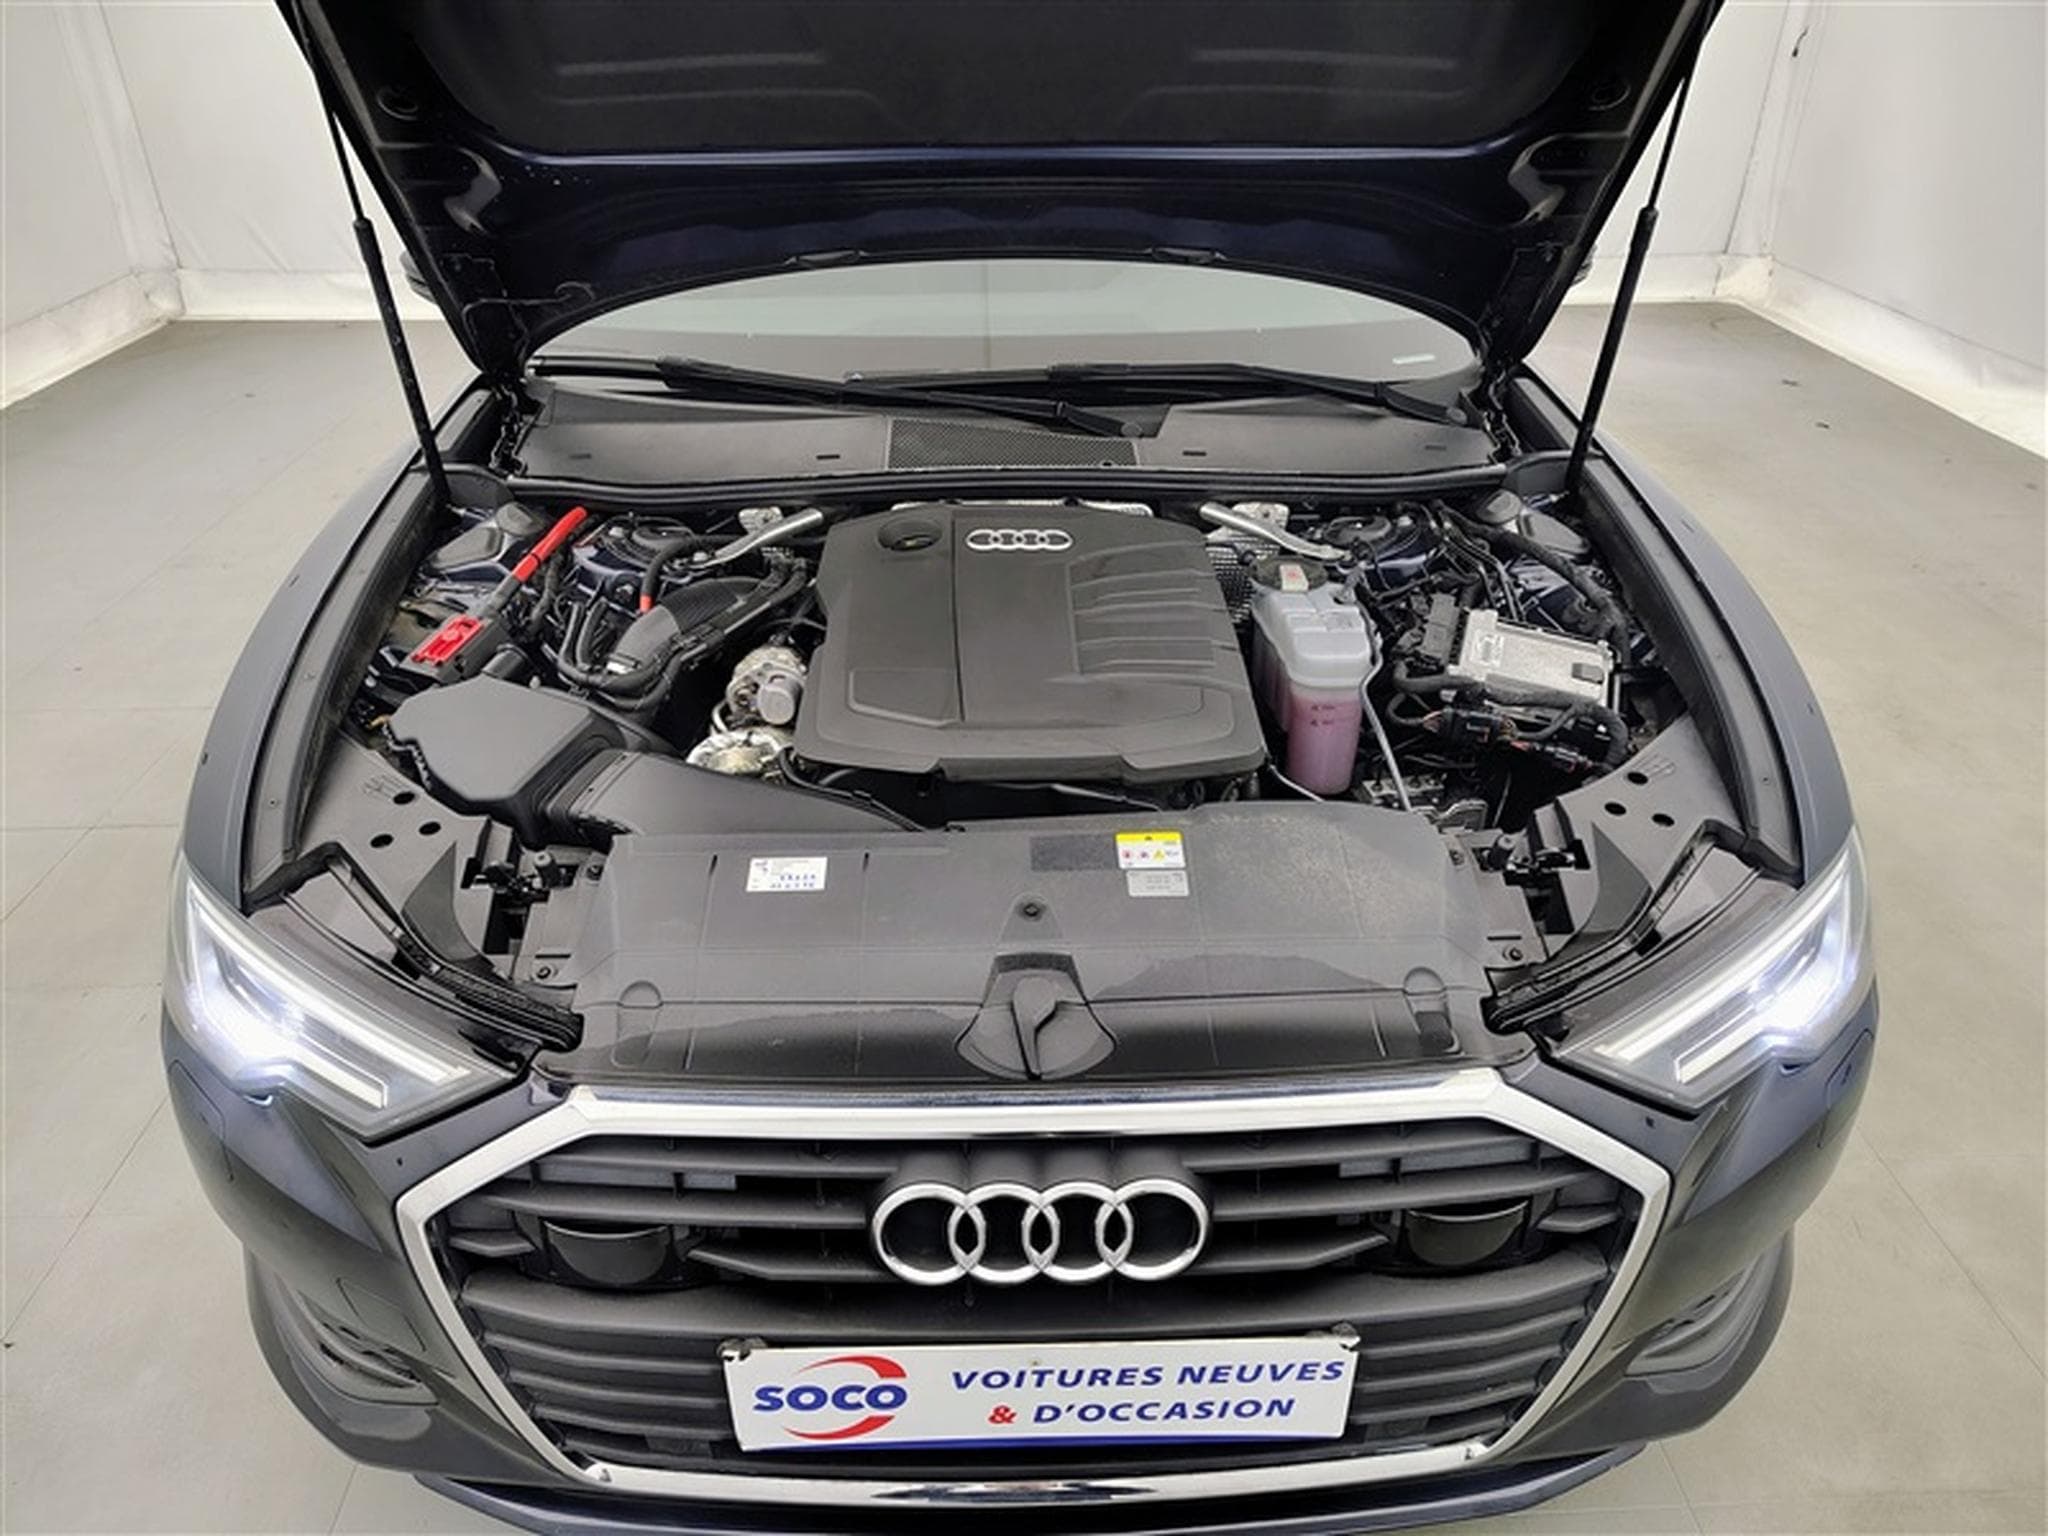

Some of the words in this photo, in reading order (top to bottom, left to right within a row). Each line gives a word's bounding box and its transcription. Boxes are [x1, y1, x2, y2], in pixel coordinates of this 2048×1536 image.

[952, 1367, 1164, 1390] VOITURES
[1177, 1361, 1345, 1385] NEUVES
[753, 1384, 908, 1411] SOCO
[988, 1405, 1017, 1425] &
[1033, 1399, 1295, 1423] D'OCCASION
